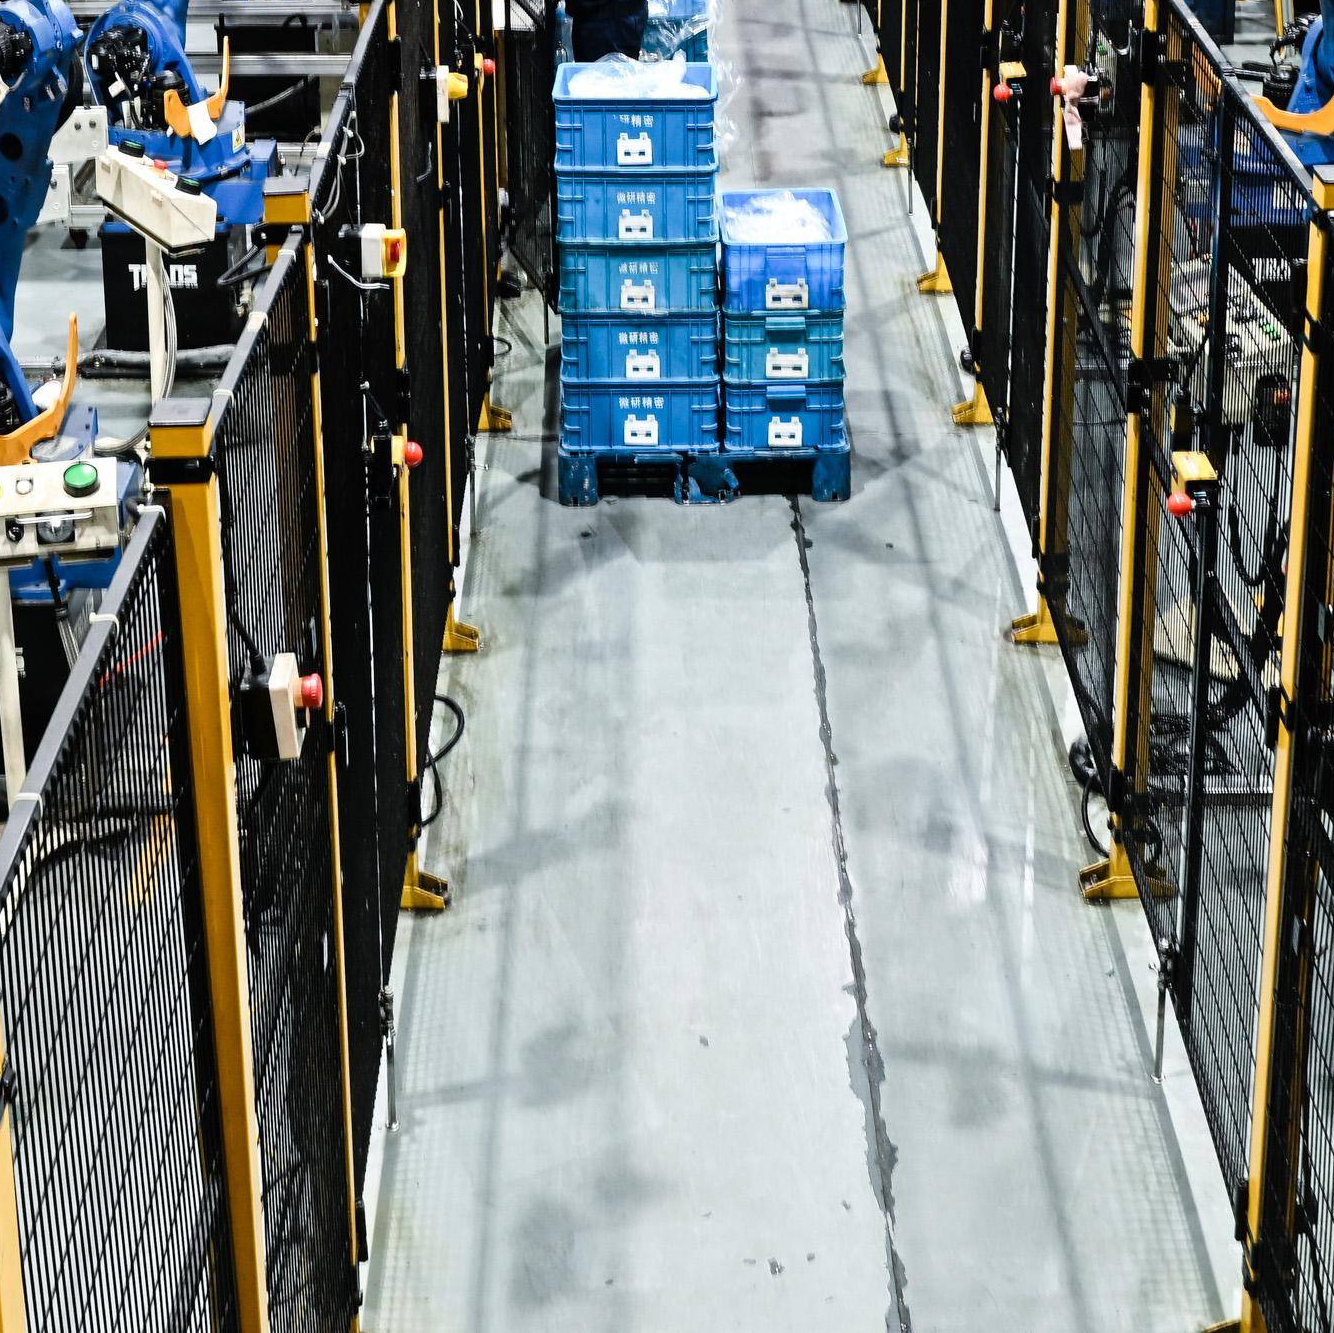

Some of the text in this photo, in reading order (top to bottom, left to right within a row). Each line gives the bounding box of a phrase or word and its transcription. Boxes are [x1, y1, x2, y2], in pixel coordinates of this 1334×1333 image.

[613, 114, 654, 128] 研精密
[128, 263, 198, 291] TNS
